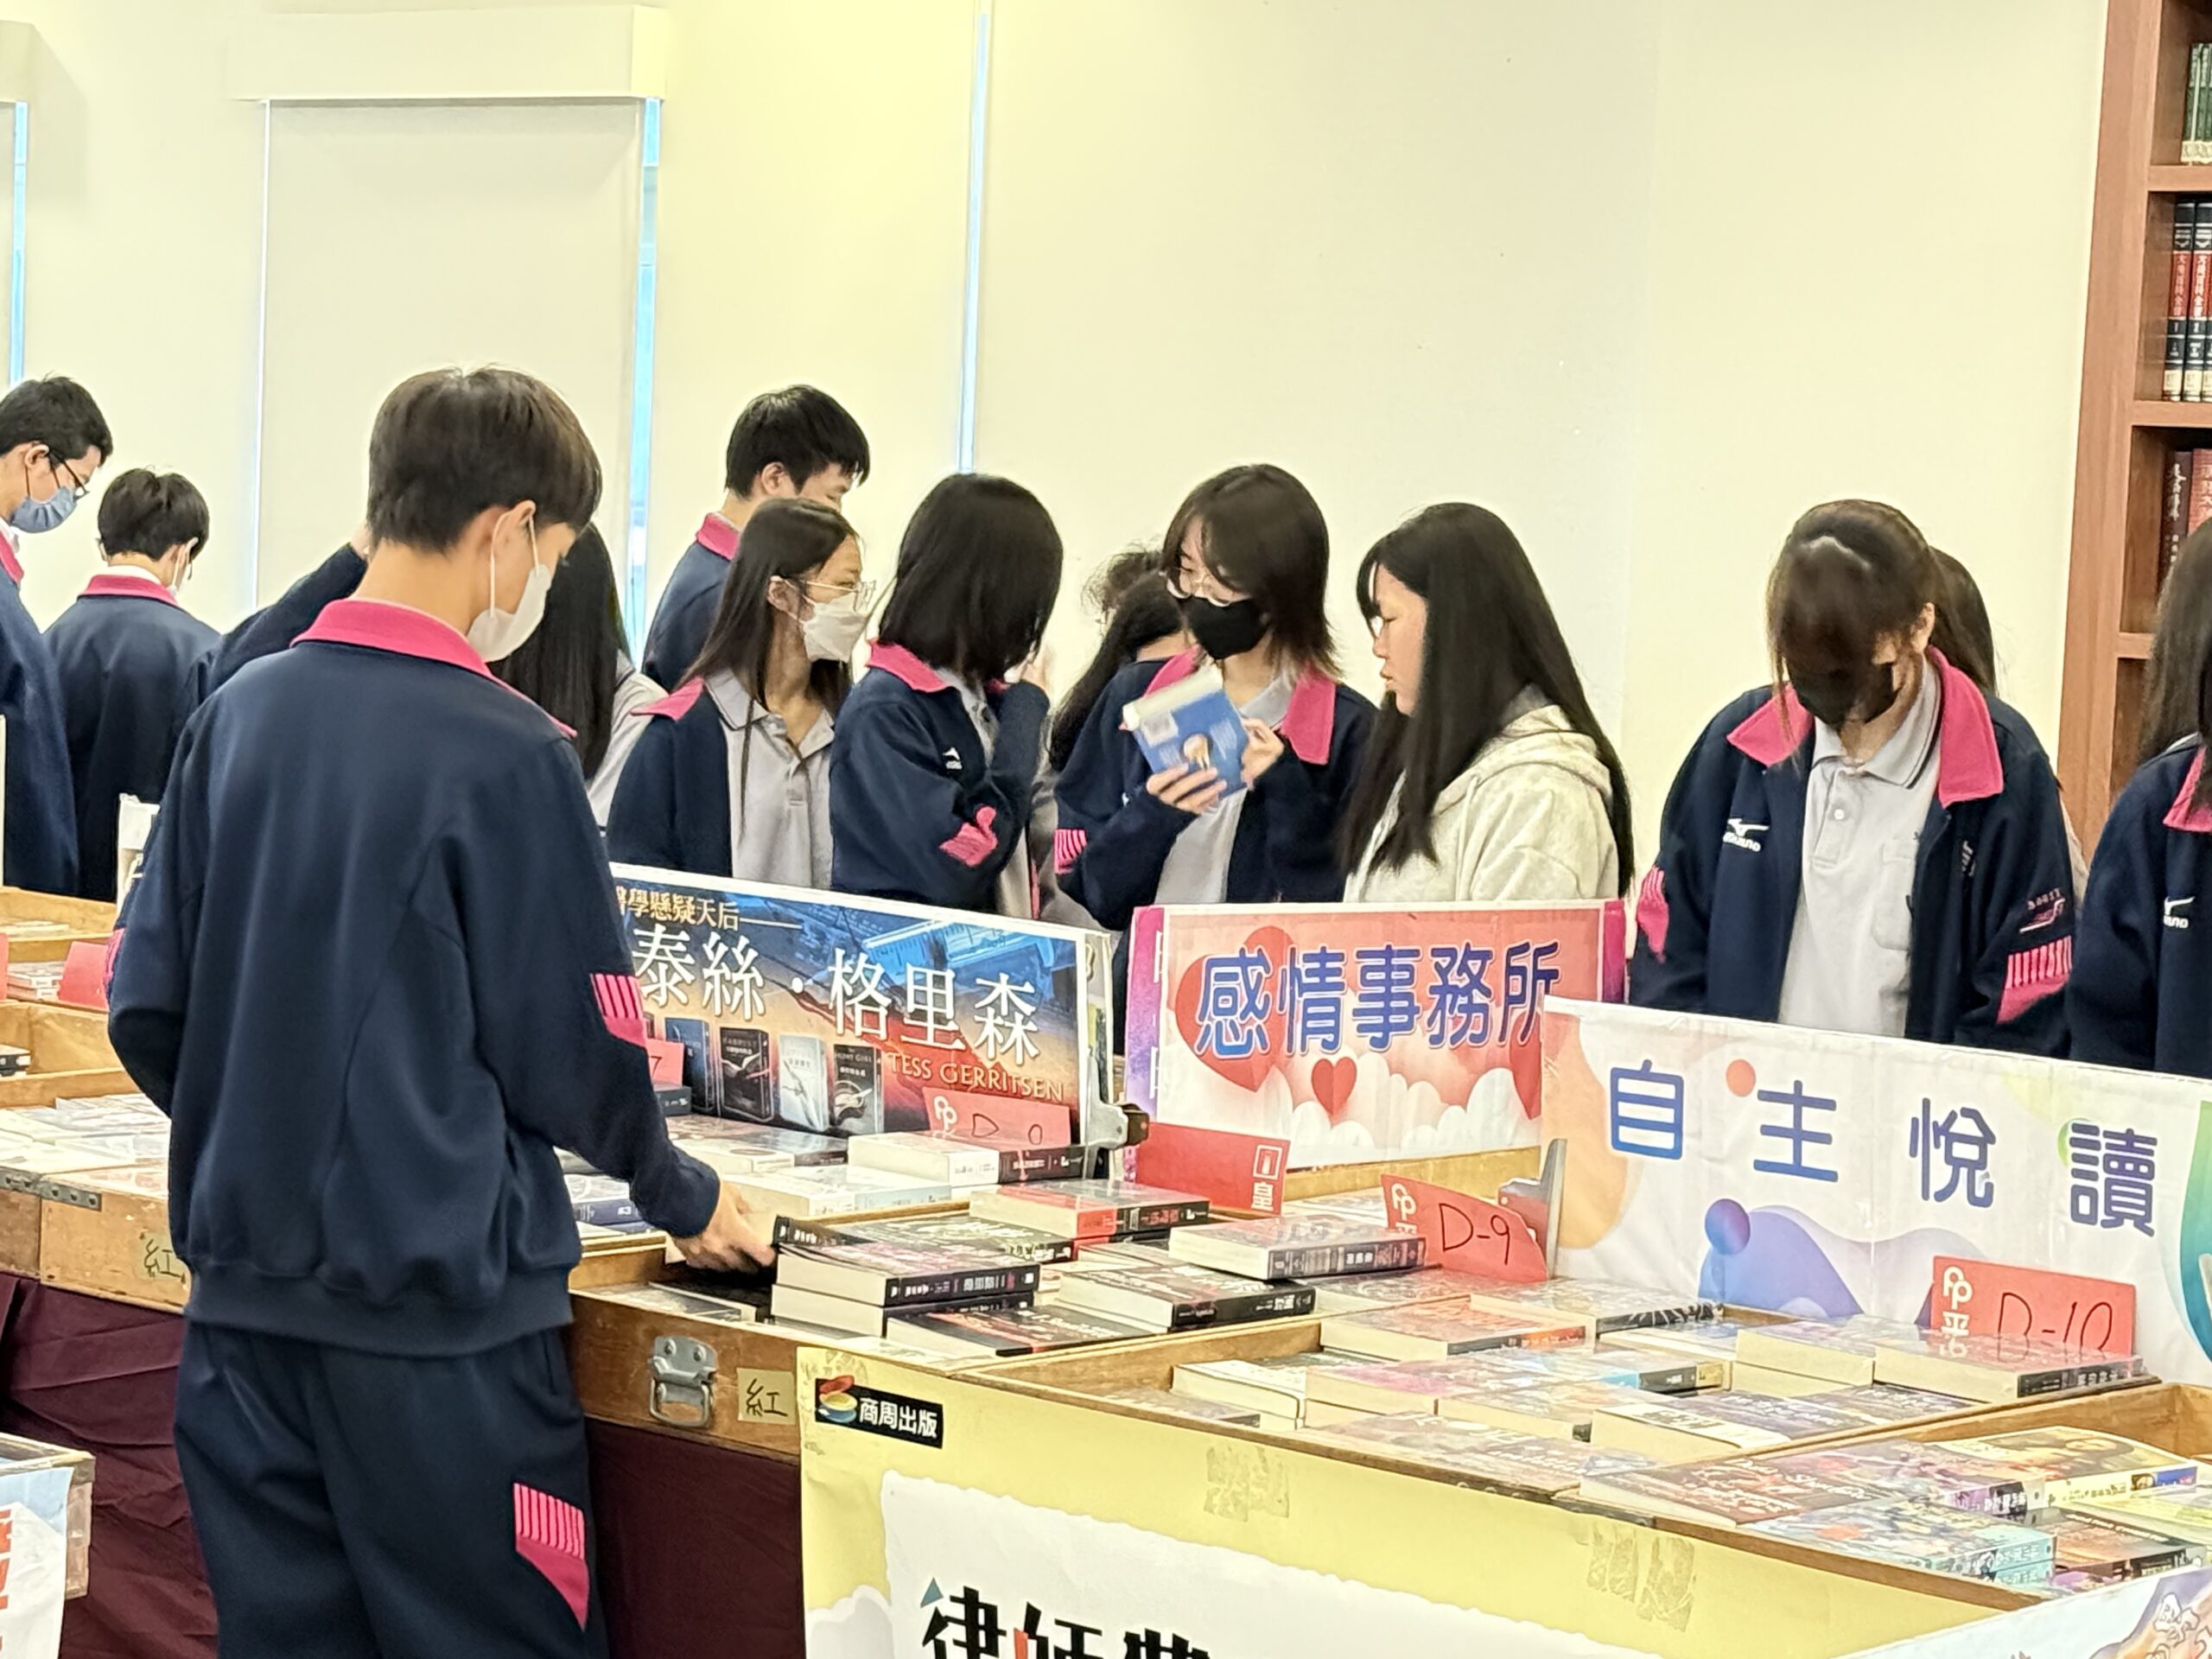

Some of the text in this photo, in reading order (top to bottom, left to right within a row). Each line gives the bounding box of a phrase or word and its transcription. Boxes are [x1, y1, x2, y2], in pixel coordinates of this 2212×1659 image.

[1195, 940, 1560, 1058] 感情事務所
[887, 1052, 1065, 1101] TESS GERRITSEN
[1610, 1058, 2158, 1237] 自主悅讀
[144, 1238, 183, 1278] 紅
[1438, 1202, 1511, 1266] D-9
[1998, 1292, 2113, 1351] D-10
[746, 1378, 788, 1417] 紅
[859, 1396, 938, 1439] 商周出版
